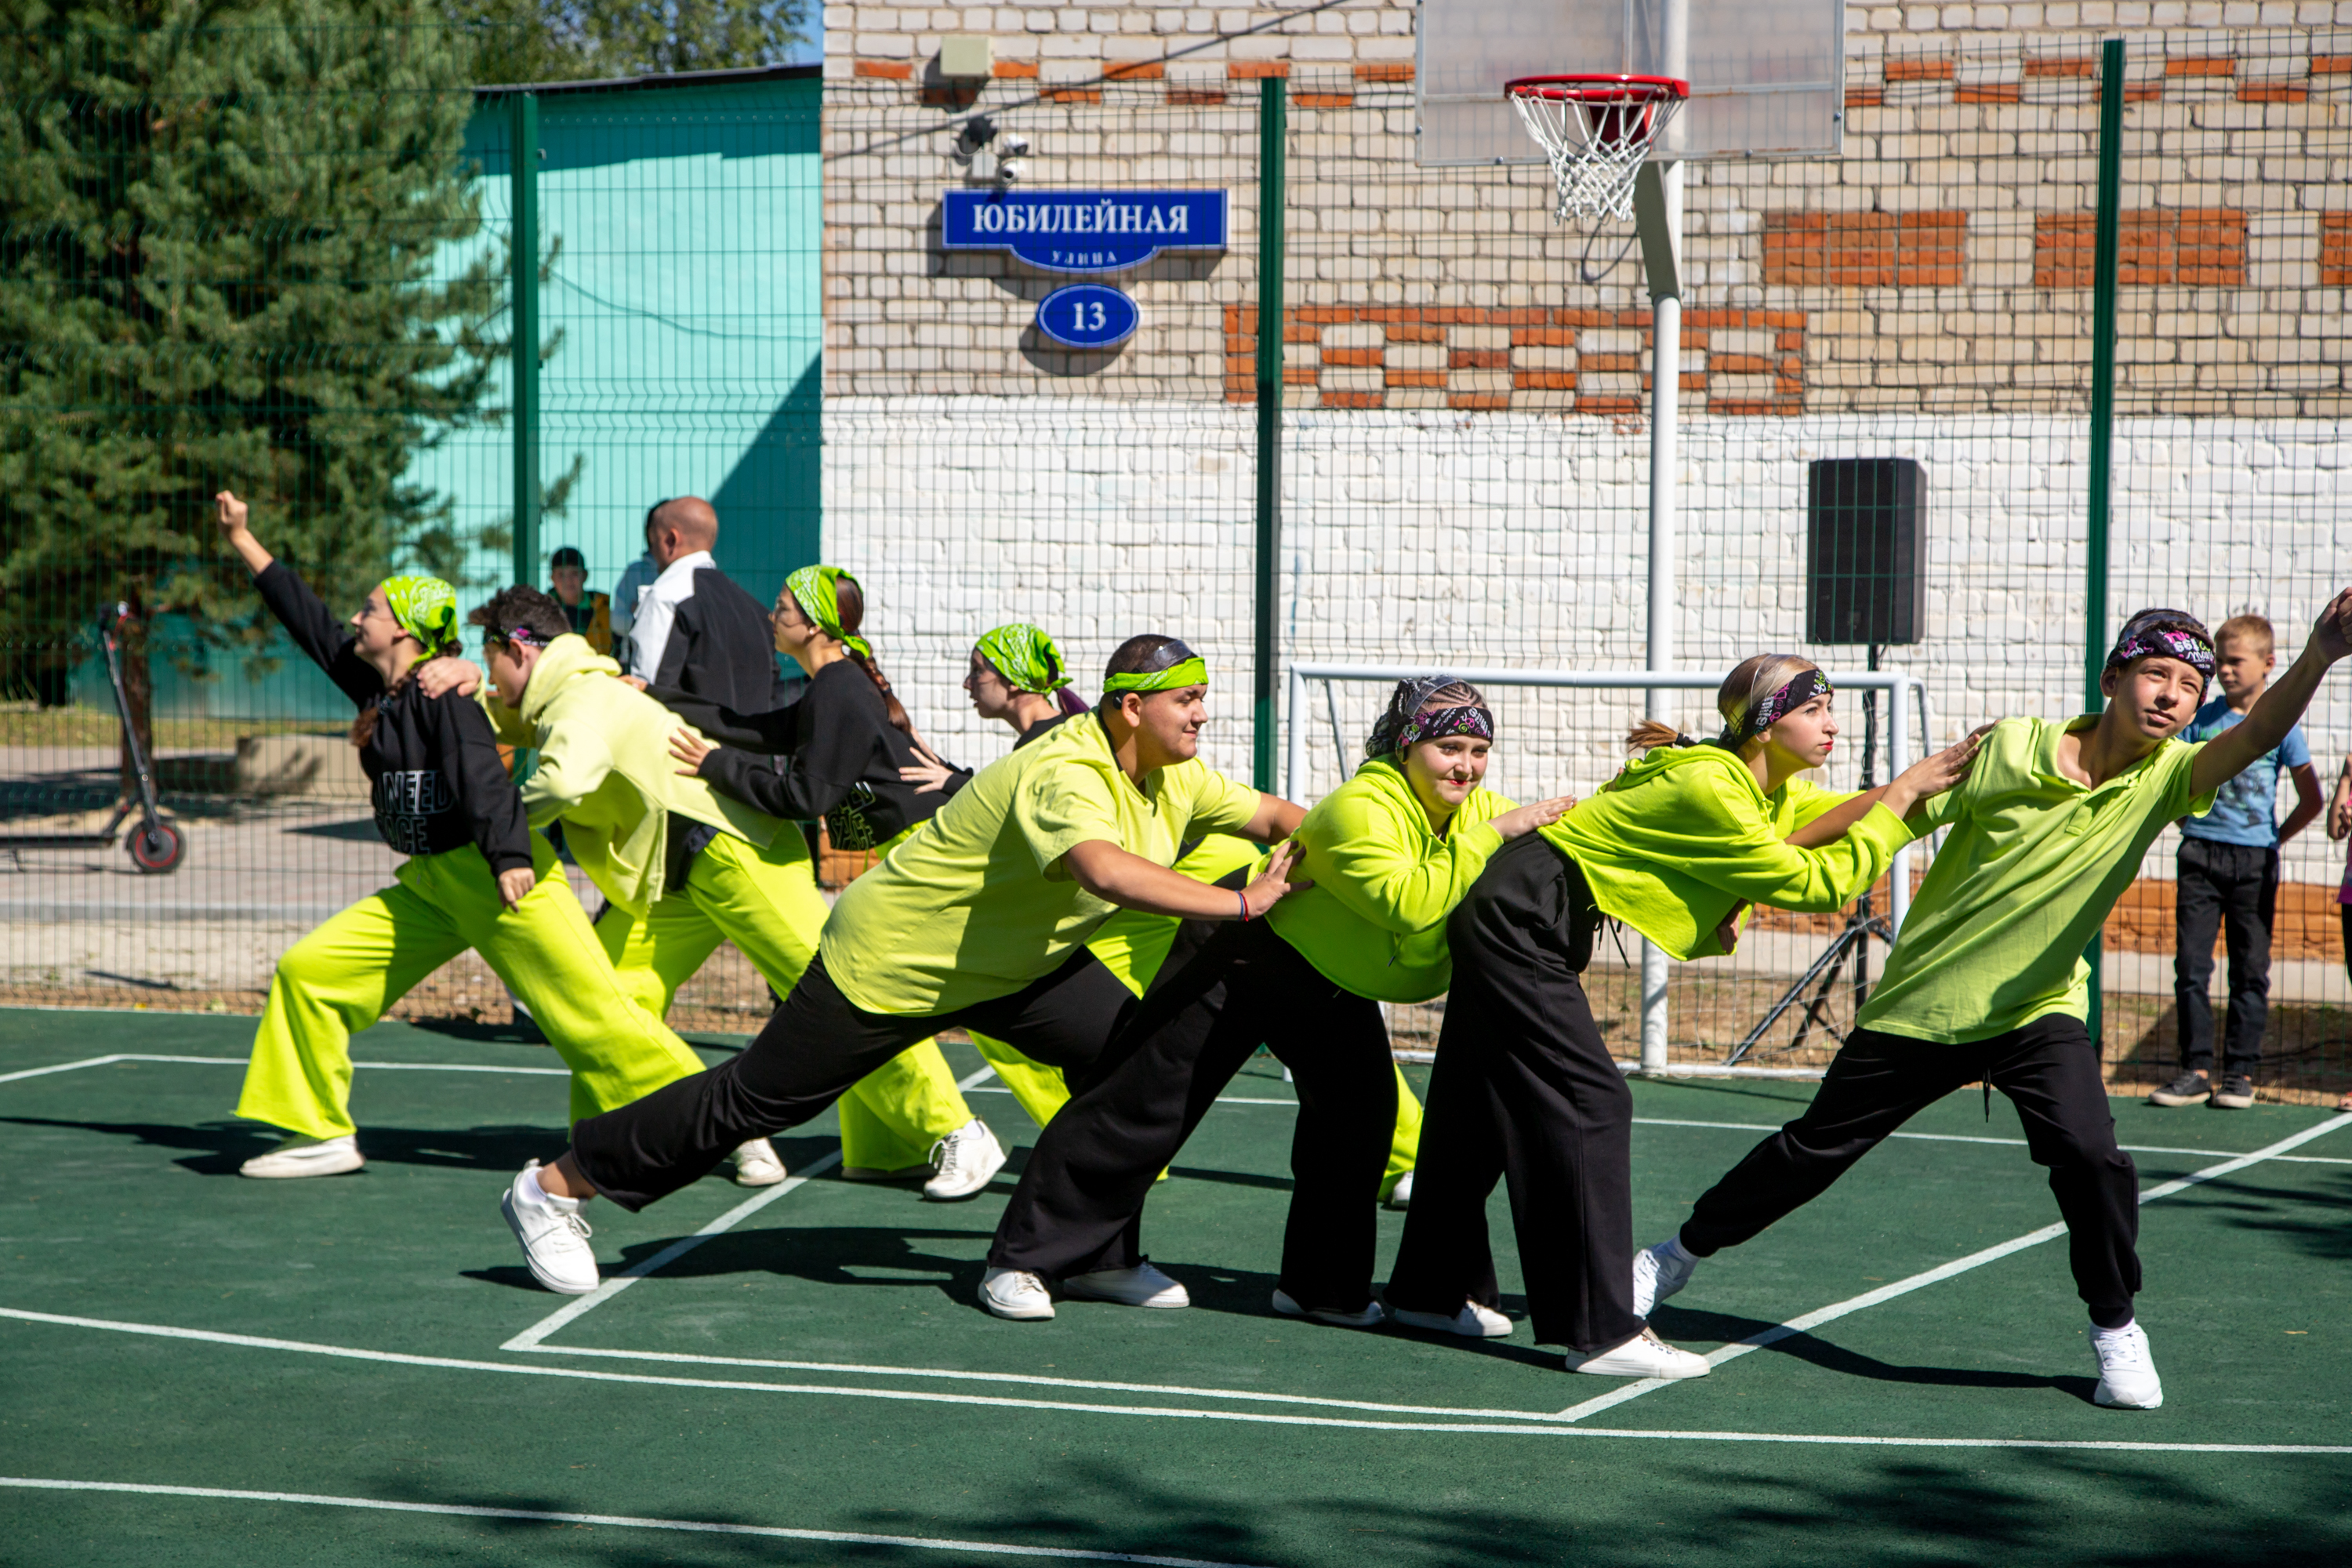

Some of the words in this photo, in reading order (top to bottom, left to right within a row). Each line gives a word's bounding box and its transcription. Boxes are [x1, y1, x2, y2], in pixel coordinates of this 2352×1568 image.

[973, 198, 1189, 233] ЮБИЛЕЙНАЯ
[1073, 302, 1107, 331] 13
[382, 769, 456, 815] NEED
